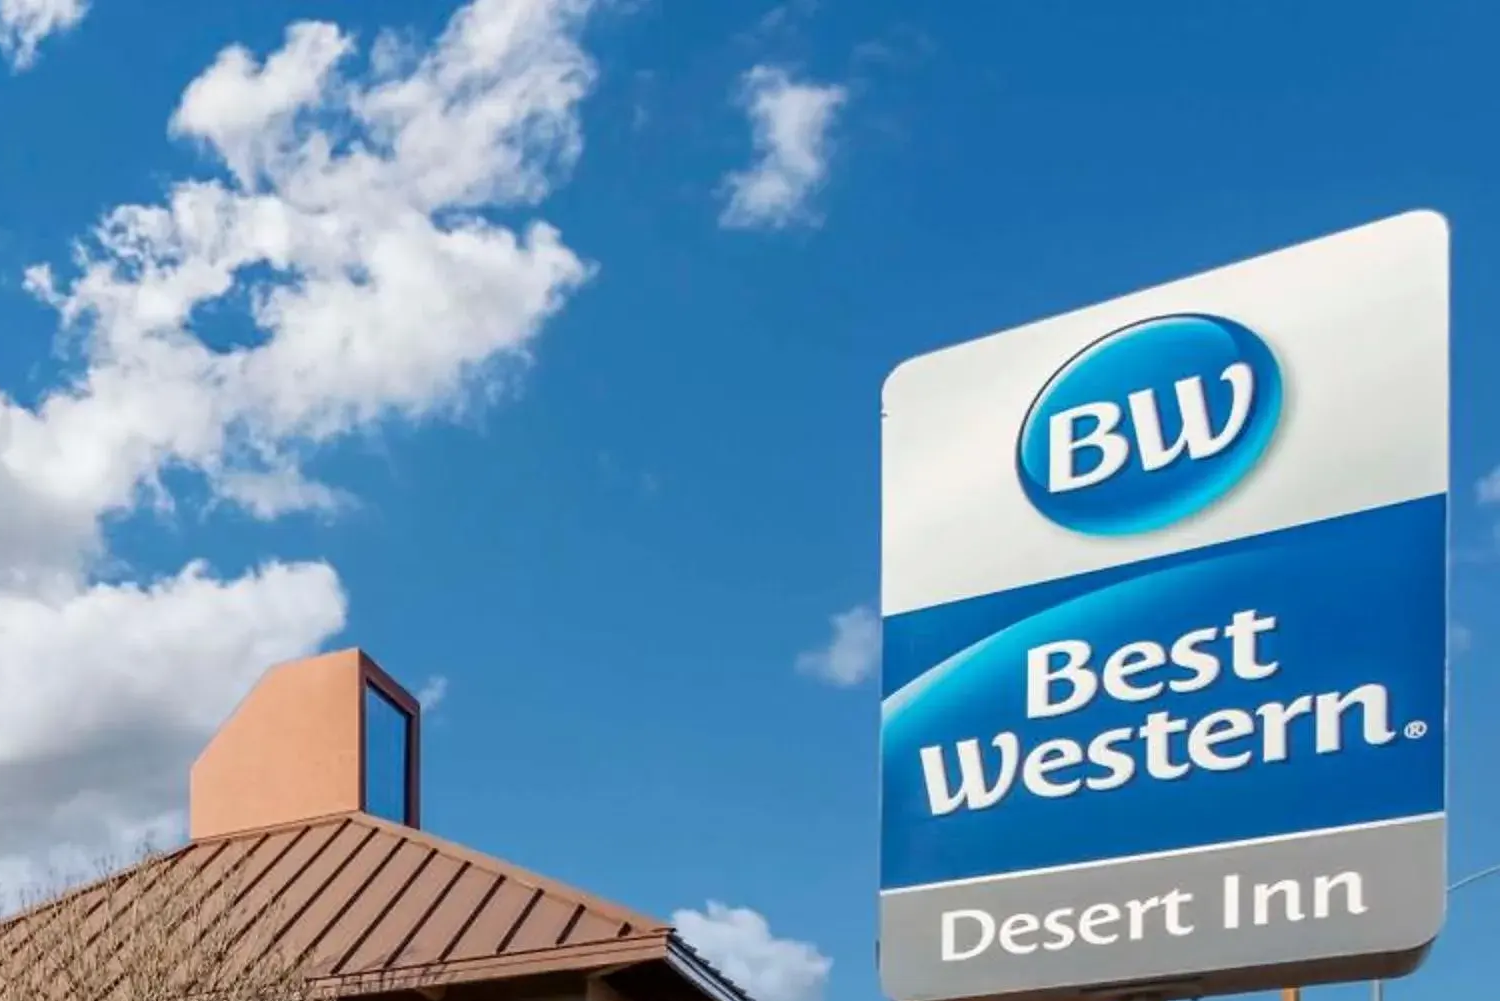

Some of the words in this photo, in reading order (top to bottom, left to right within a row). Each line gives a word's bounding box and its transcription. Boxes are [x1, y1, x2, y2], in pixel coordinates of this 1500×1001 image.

[1048, 362, 1254, 494] BW
[1026, 609, 1279, 719] Best
[941, 885, 1193, 962] Desert
[1223, 869, 1367, 929] Inn
